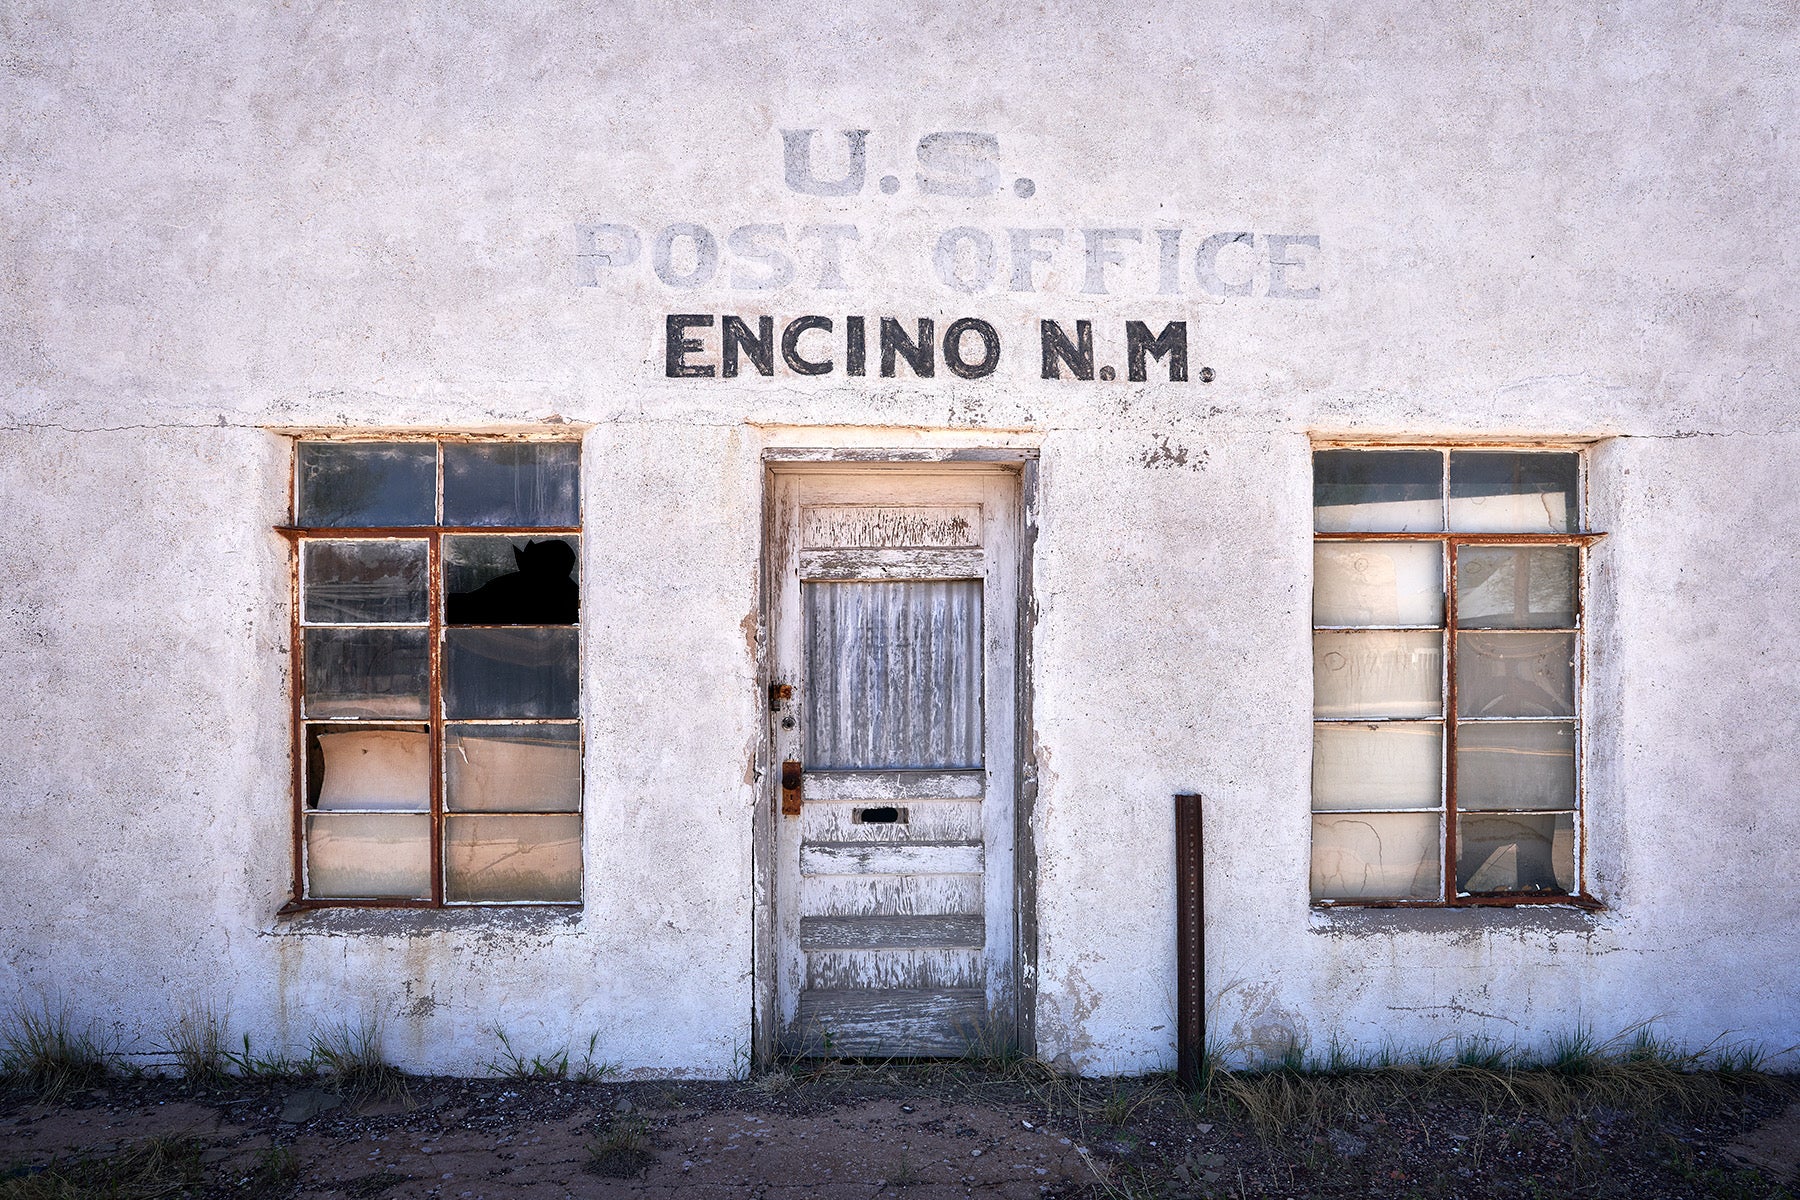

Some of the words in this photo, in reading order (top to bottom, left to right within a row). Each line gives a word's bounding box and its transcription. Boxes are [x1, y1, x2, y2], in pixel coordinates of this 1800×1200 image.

[781, 128, 1036, 199] U.S.
[574, 222, 861, 290] POST
[931, 226, 1321, 299] OFFICE
[666, 314, 1001, 379] ENCINO
[1041, 318, 1216, 383] N.M.
